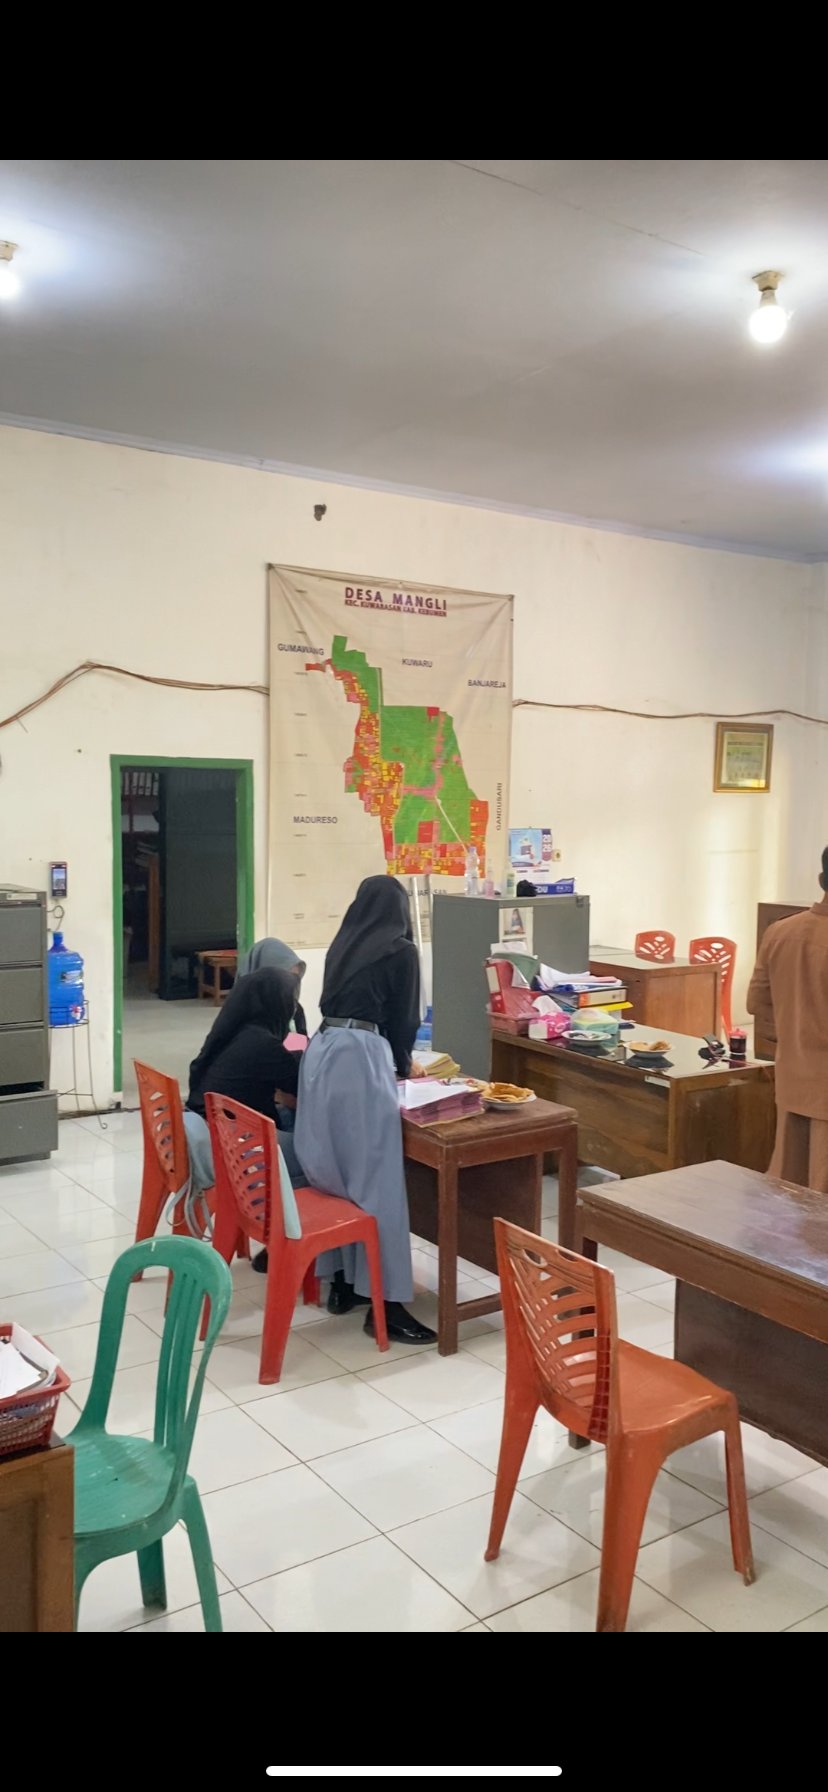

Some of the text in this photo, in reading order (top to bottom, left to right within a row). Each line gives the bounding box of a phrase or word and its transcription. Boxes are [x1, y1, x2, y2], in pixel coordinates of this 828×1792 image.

[345, 587, 447, 610] DESA MANGLI
[402, 658, 433, 668] KUWARU
[293, 816, 338, 824] MADURESO
